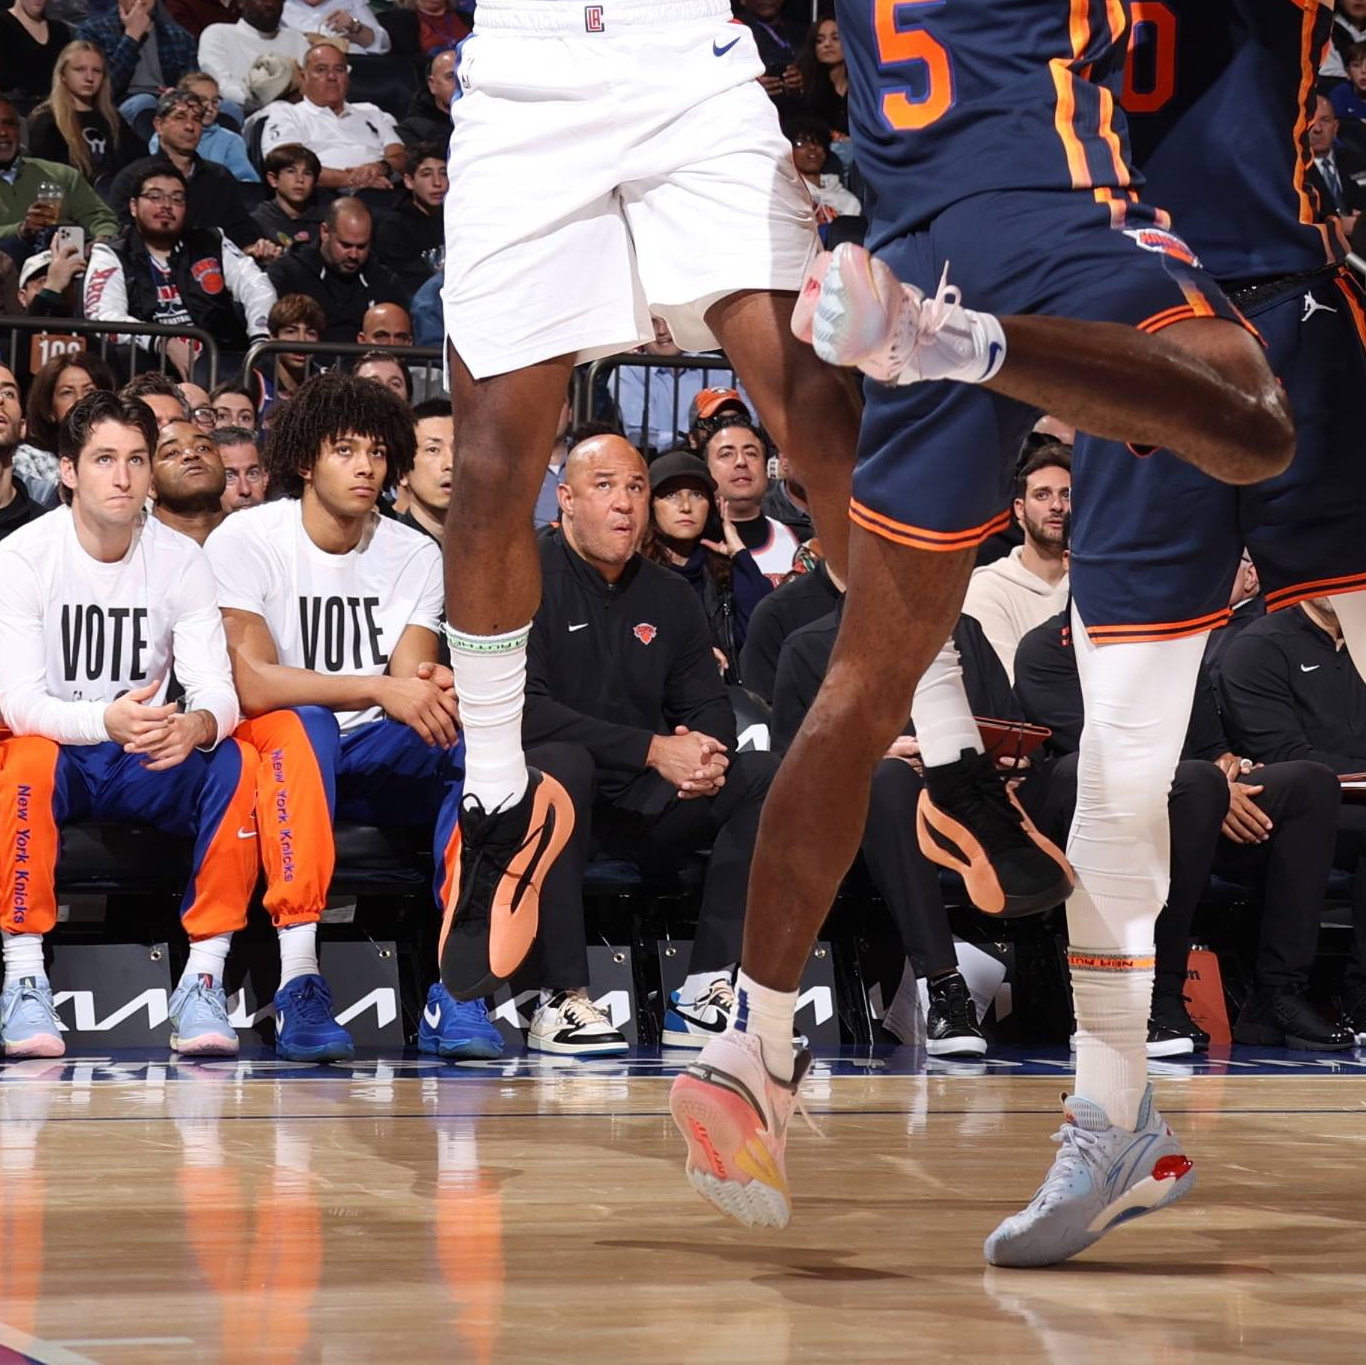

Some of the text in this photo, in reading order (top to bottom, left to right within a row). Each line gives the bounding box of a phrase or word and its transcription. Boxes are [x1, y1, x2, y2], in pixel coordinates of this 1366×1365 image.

[1120, 0, 1177, 113] 0
[61, 604, 148, 681] VOTE
[299, 595, 388, 673] VOTE
[13, 784, 31, 924] New York Knicks
[271, 749, 293, 883] New York Knicks
